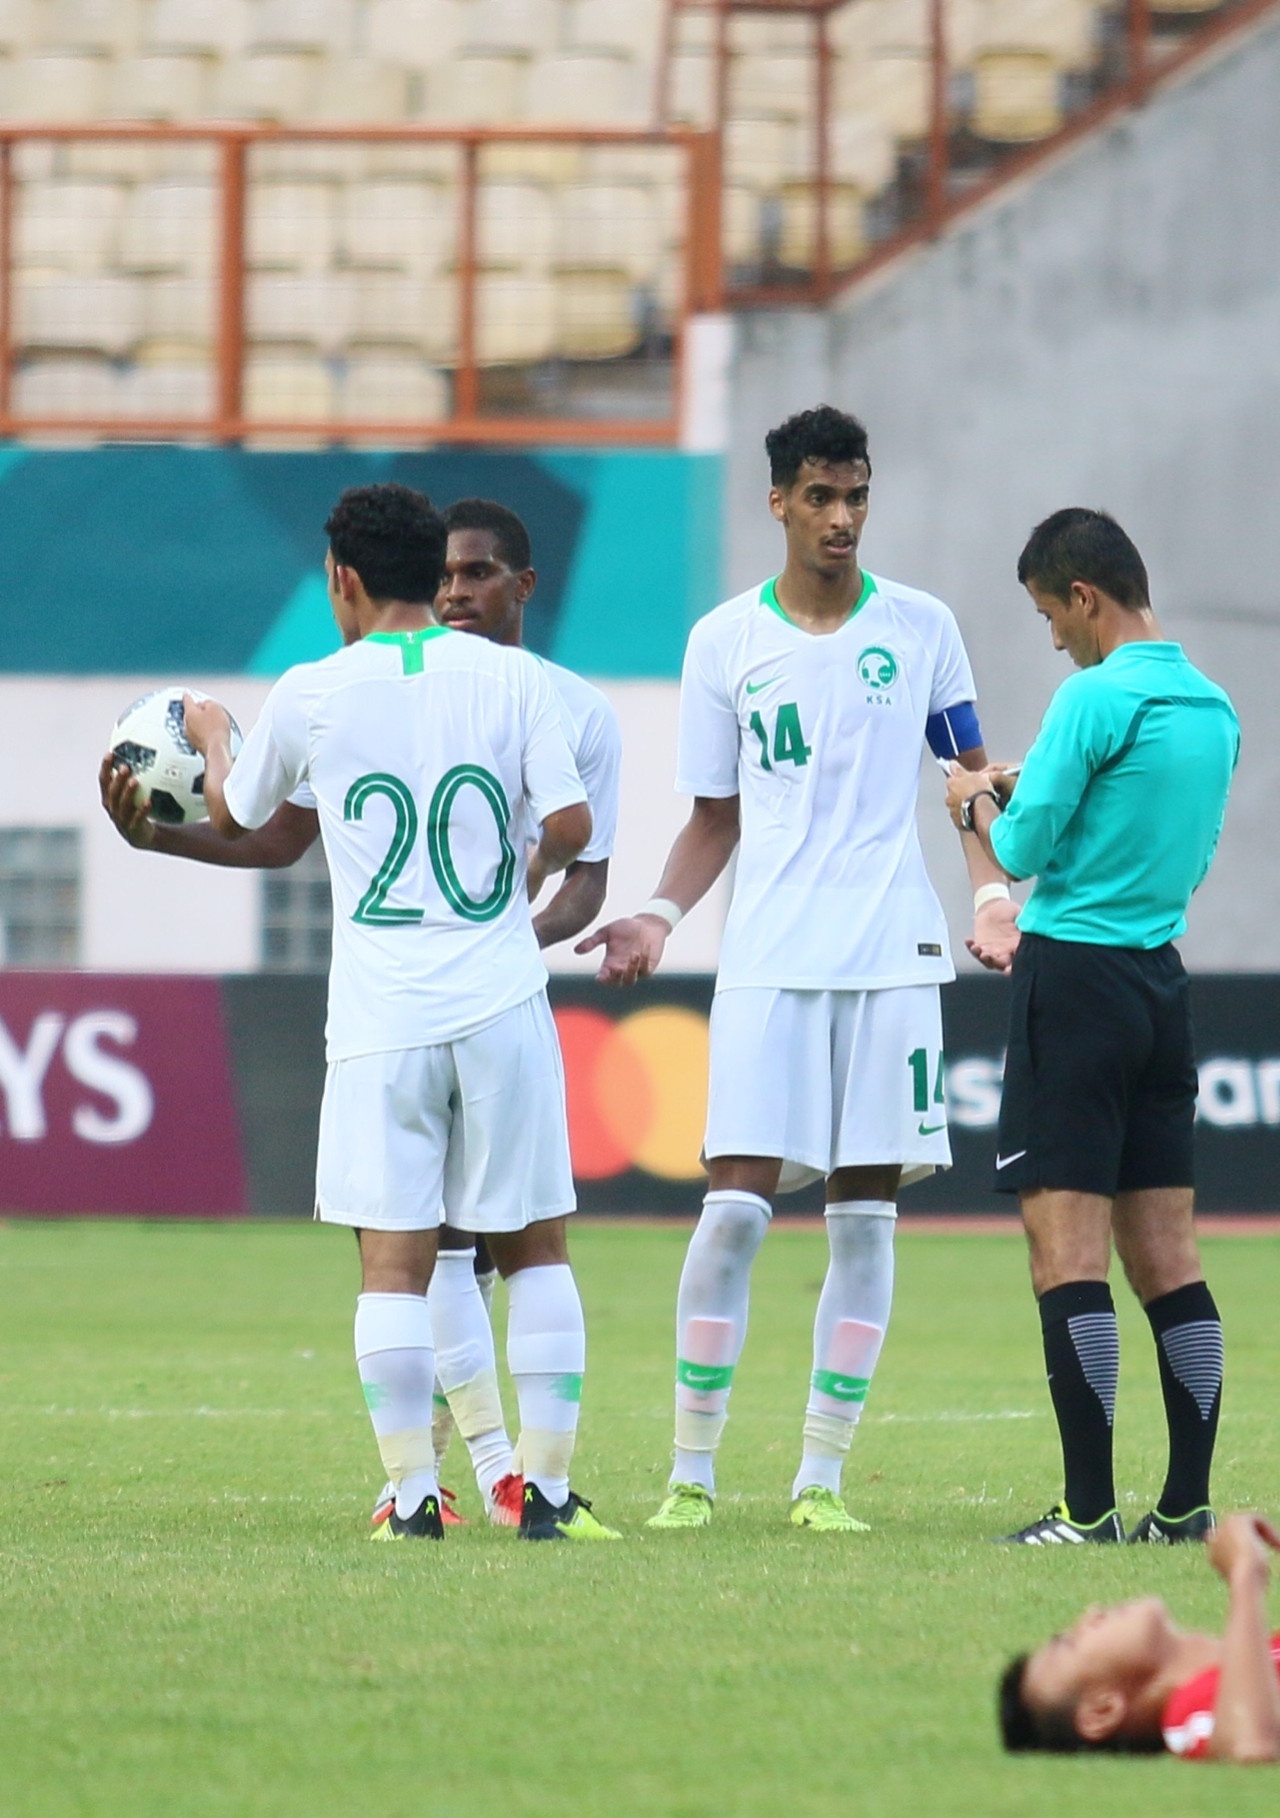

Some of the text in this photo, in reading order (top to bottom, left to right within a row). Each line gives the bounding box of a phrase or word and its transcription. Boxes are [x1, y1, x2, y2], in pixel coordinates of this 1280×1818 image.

[750, 702, 812, 771] 14
[866, 695, 892, 706] KSA
[343, 763, 516, 926] 20
[0, 1009, 156, 1143] YS
